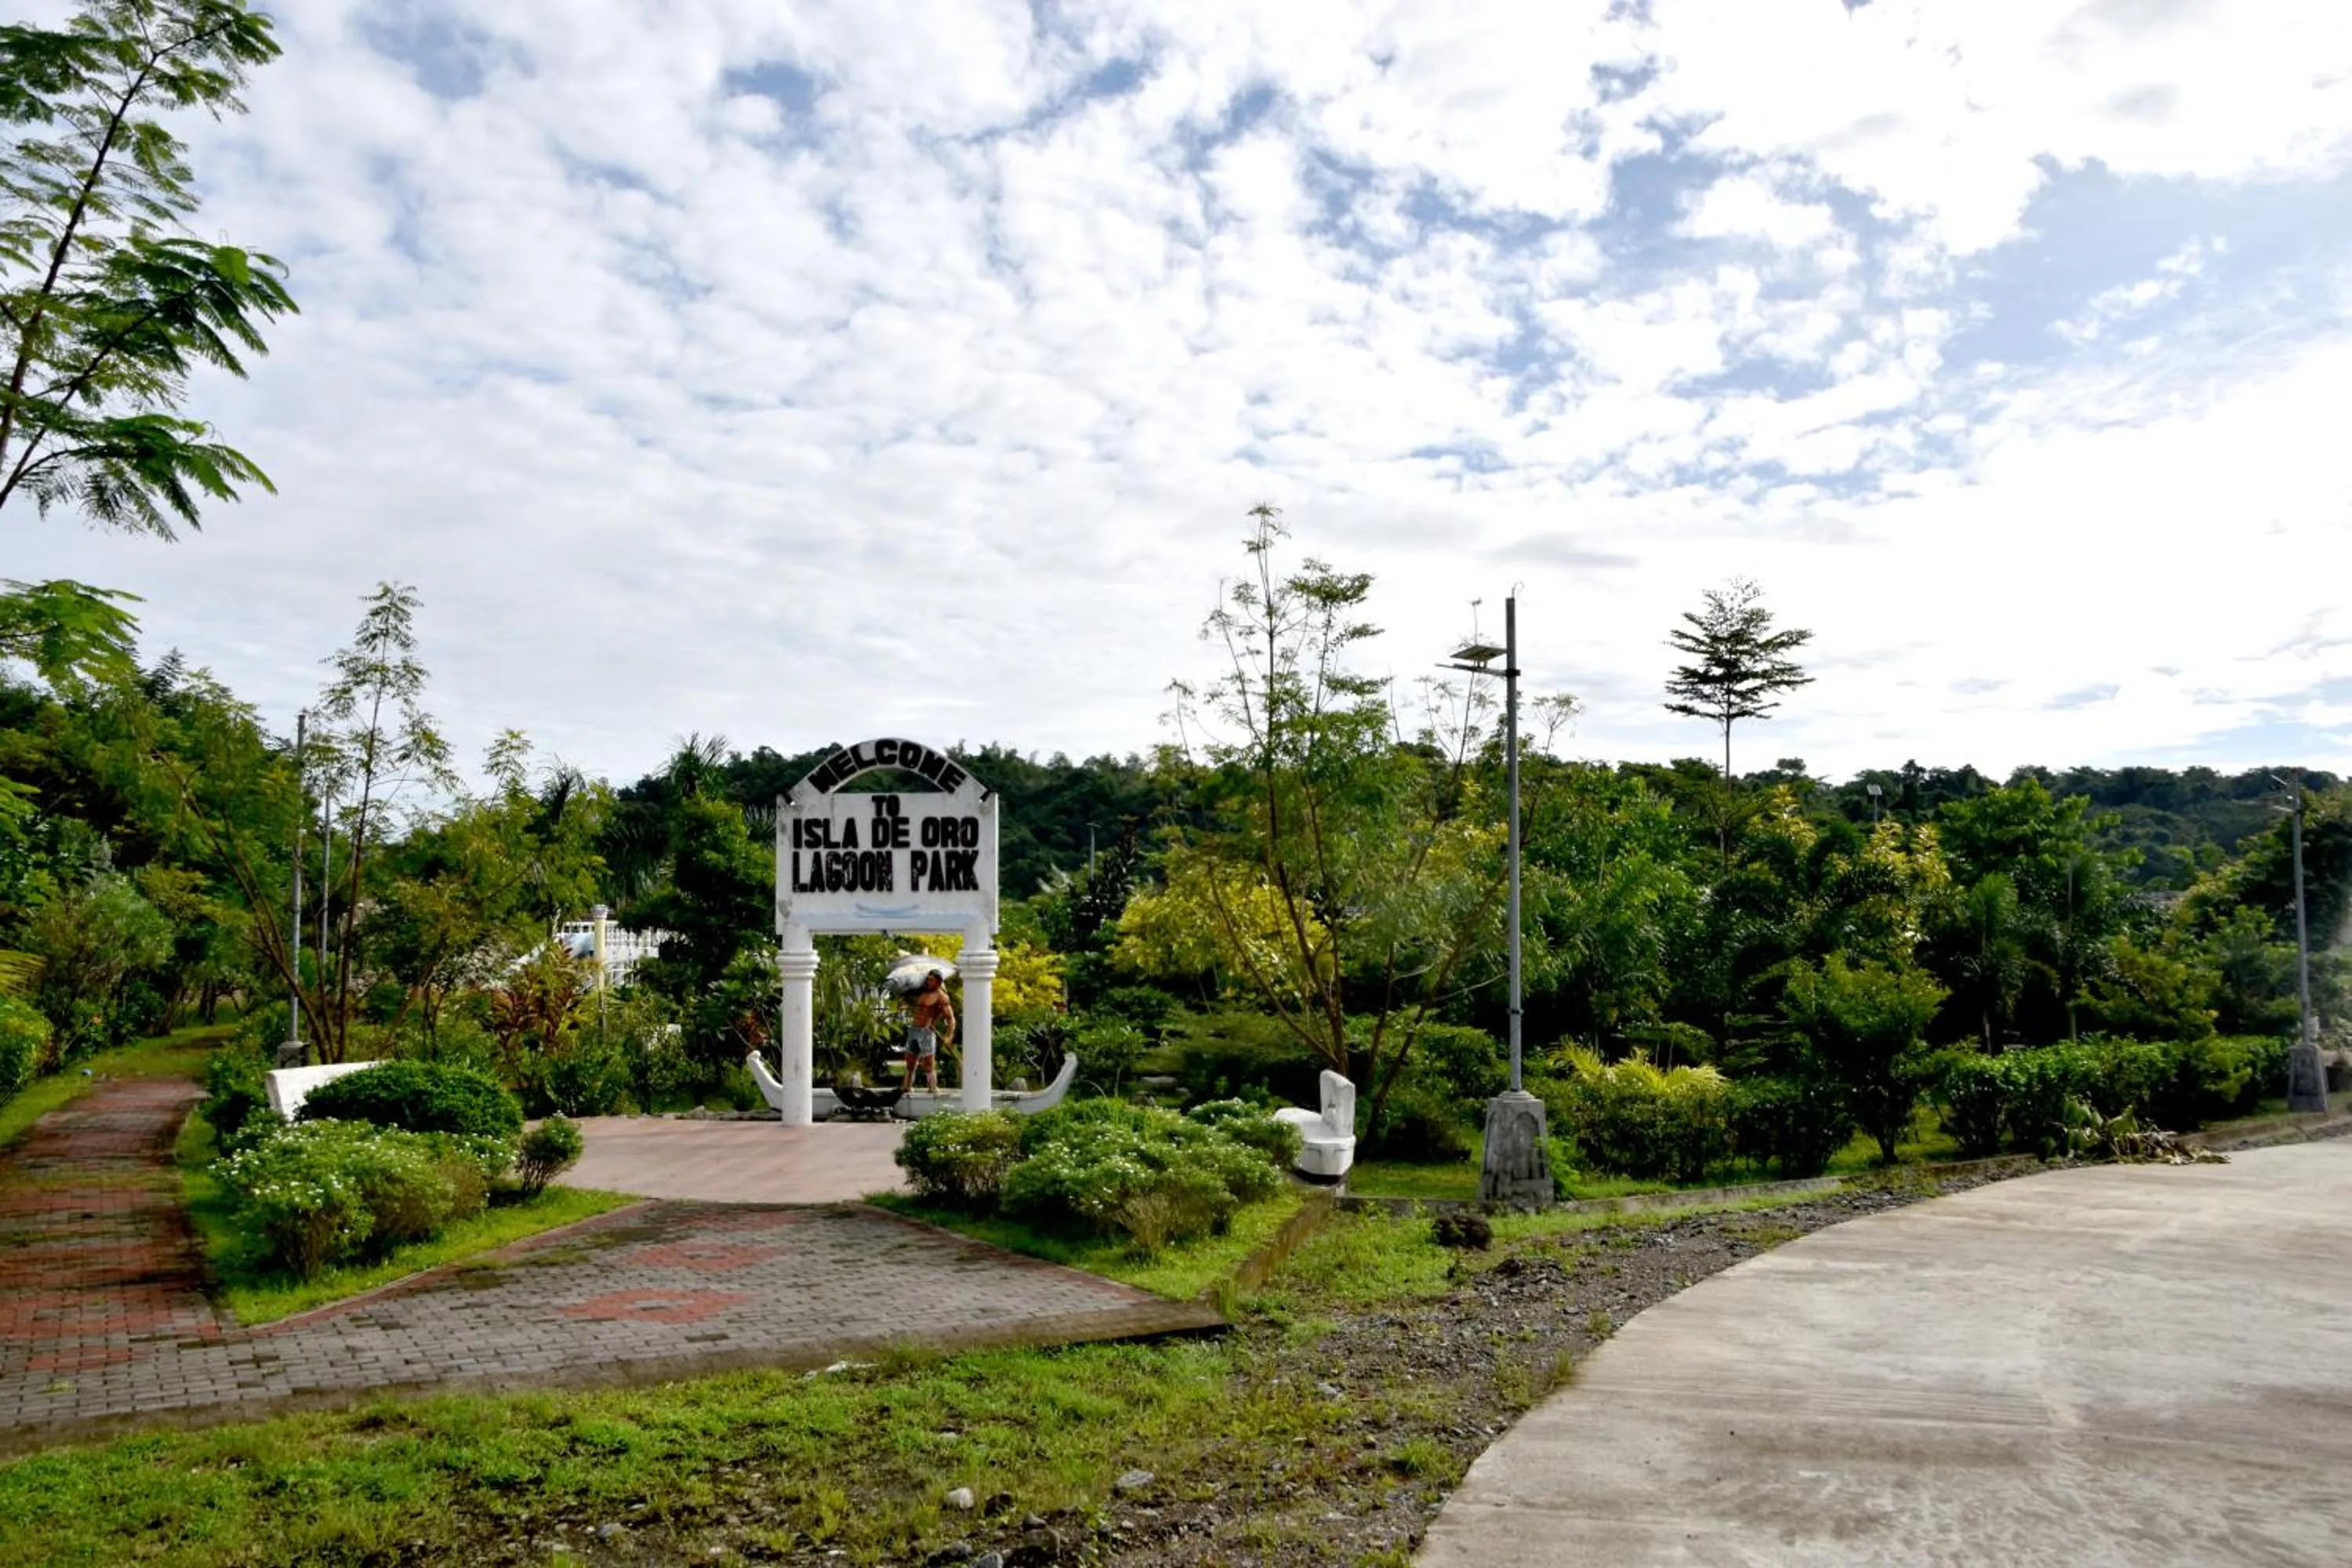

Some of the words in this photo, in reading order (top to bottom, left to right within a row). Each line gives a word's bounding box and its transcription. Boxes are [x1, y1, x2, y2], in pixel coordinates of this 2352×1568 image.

[807, 739, 967, 794] WELCOME
[871, 794, 901, 817] TO
[793, 818, 858, 849] ISLA
[871, 817, 910, 848] DE
[921, 817, 978, 848] ORO
[792, 851, 893, 892] LAGOON
[911, 850, 979, 891] PARK
